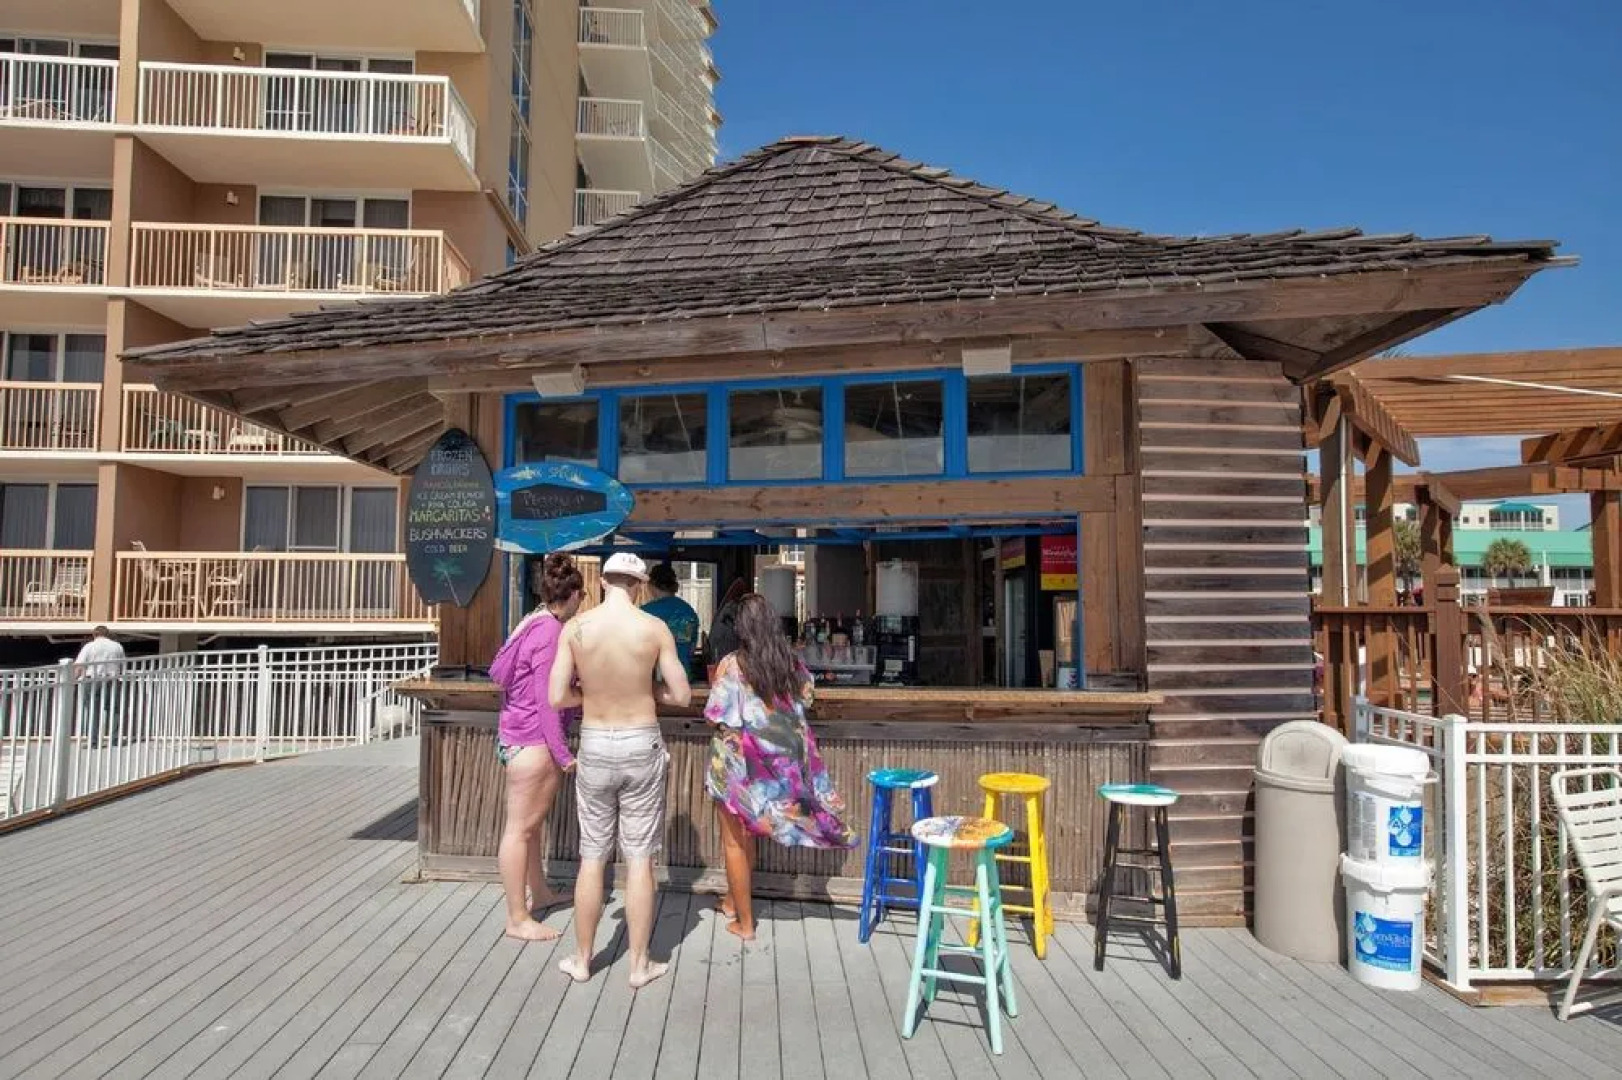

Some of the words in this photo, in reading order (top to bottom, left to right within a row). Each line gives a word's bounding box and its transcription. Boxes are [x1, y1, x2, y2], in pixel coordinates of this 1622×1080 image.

[430, 450, 473, 462] FROZEN
[409, 508, 480, 523] MARGARITAS
[410, 527, 487, 542] BUSHWACKERS
[425, 544, 445, 553] COLD
[448, 544, 468, 553] BEER
